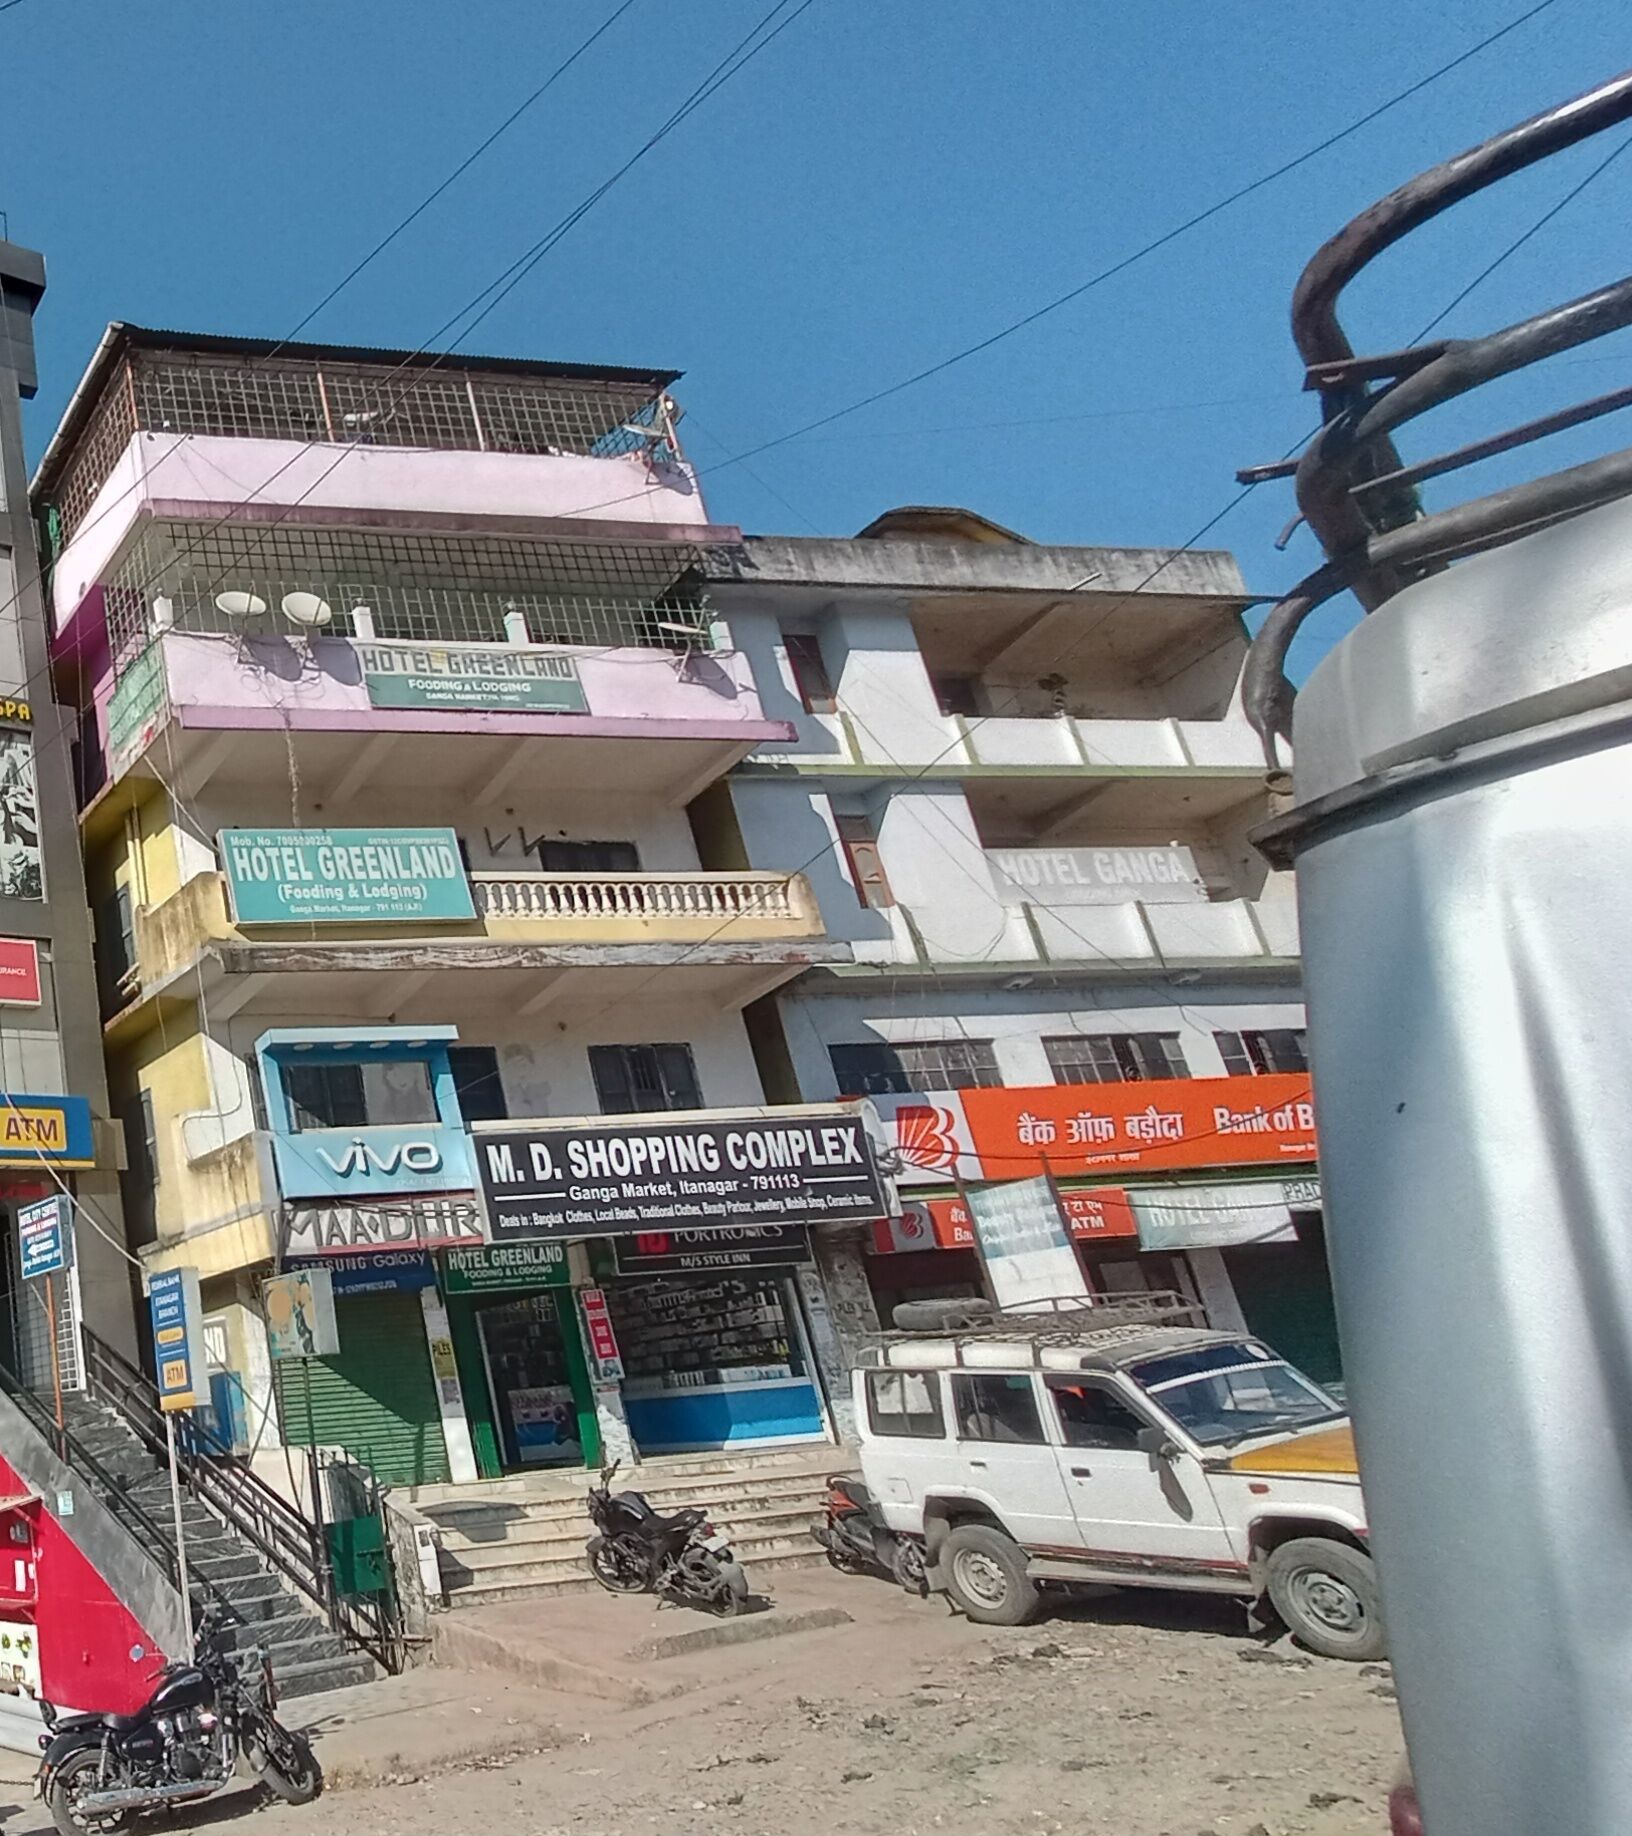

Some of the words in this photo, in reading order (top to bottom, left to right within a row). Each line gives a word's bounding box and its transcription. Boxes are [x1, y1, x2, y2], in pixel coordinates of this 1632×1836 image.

[363, 650, 443, 674] HOTEL
[448, 651, 573, 678] GREENLAND
[408, 679, 462, 691] FOODING
[473, 681, 532, 692] LODGING
[257, 836, 274, 846] No.
[233, 847, 314, 882] HOTEL
[318, 845, 456, 881] GREENLAND
[994, 851, 1091, 886] HOTEL
[1093, 850, 1191, 885] GANGA
[278, 884, 344, 903] (Fooding
[348, 885, 363, 898] &
[363, 882, 428, 901] Lodging)
[5, 1117, 58, 1142] ATM
[1017, 1112, 1056, 1146] बैंक
[1123, 1104, 1184, 1144] बड़ौदा
[1213, 1104, 1271, 1134] Bank
[1272, 1104, 1294, 1132] of
[316, 1136, 441, 1174] vivo
[486, 1143, 526, 1184] M.
[528, 1141, 563, 1182] D.
[568, 1132, 720, 1179] SHOPPING
[725, 1127, 864, 1171] COMPLEX
[568, 1183, 620, 1203] Ganga
[622, 1179, 677, 1199] Market,
[680, 1177, 739, 1197] Itanagar
[751, 1173, 800, 1190] 791113
[1070, 1215, 1105, 1230] ATM
[372, 1252, 425, 1269] Galaxy
[448, 1251, 489, 1270] HOTEL
[491, 1245, 563, 1266] GREENLAND
[513, 1265, 552, 1275] LODGING
[680, 1257, 702, 1268] M/S
[703, 1255, 730, 1265] STYLE
[732, 1254, 751, 1263] INN
